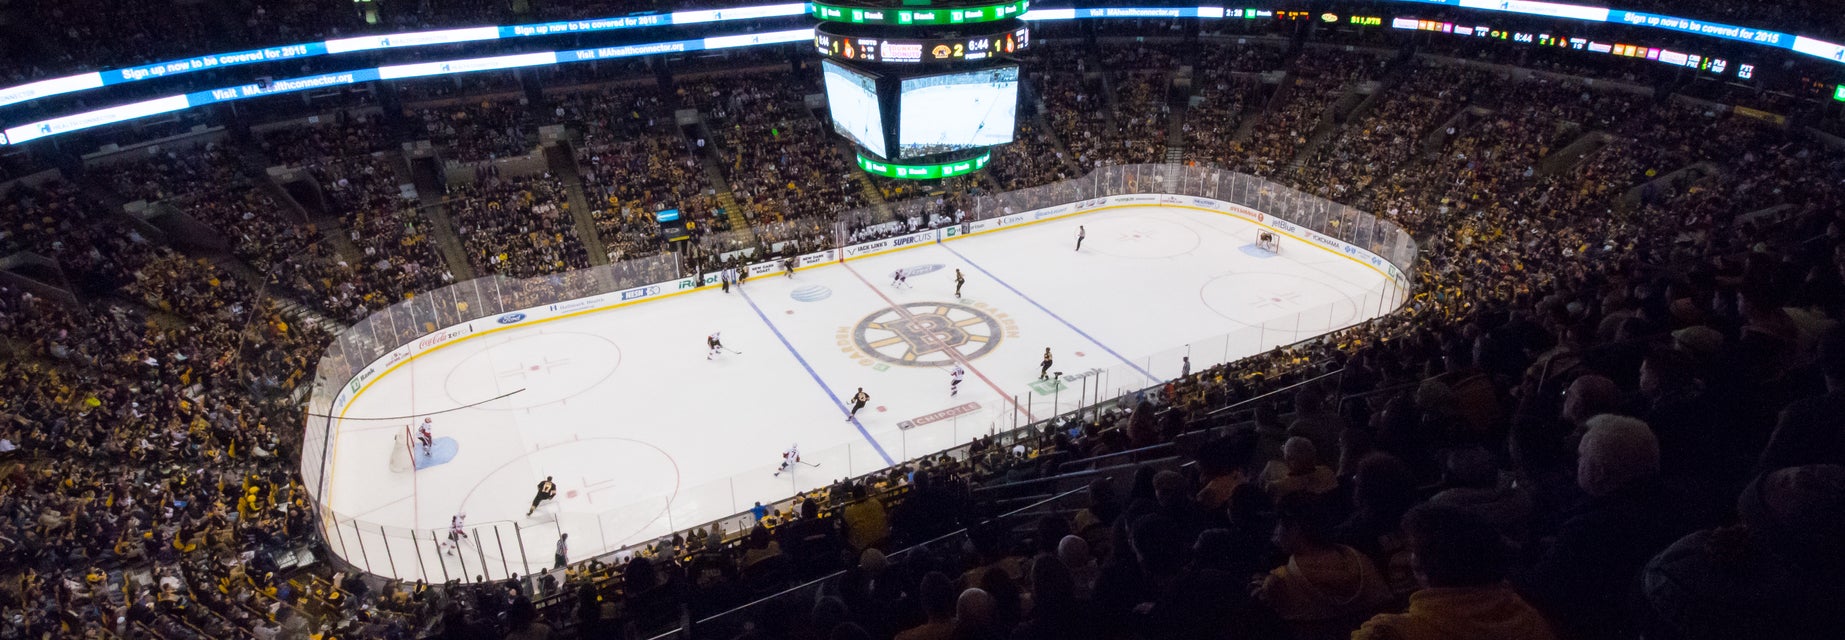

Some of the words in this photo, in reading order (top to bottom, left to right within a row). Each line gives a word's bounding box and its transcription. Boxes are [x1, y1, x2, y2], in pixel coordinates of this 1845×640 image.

[864, 11, 884, 20] Bank
[965, 10, 983, 18] Bank
[514, 26, 534, 36] Sign
[536, 25, 549, 34] up
[550, 24, 568, 32] now
[568, 22, 578, 30] to
[580, 20, 590, 29] be
[592, 18, 624, 28] covered
[625, 17, 638, 26] for
[1624, 12, 1646, 24] Sign
[1648, 16, 1660, 26] up
[1660, 18, 1679, 28] now
[1680, 20, 1688, 29] to
[1690, 22, 1701, 31] be
[1702, 24, 1739, 37] covered
[1740, 28, 1753, 40] for
[1755, 31, 1780, 44] 2015
[954, 44, 964, 57] 2
[968, 38, 988, 50] 6:44
[994, 40, 1001, 52] 1
[576, 50, 594, 60] Visit
[599, 42, 684, 58] MAhealthconnector.org
[122, 68, 149, 80] Sign
[150, 66, 166, 76] up
[168, 62, 190, 72] now
[191, 60, 201, 68] to
[204, 56, 218, 66] be
[220, 51, 264, 64] covered
[264, 49, 280, 58] for
[282, 45, 307, 57] 2015
[212, 89, 238, 100] Visit
[1272, 220, 1296, 232] jetBlue
[893, 232, 931, 247] SUPERCUTS
[502, 314, 522, 324] Ford
[974, 302, 1020, 338] GARDEN
[360, 368, 374, 381] Bank
[915, 402, 978, 426] CHIPOTLE
